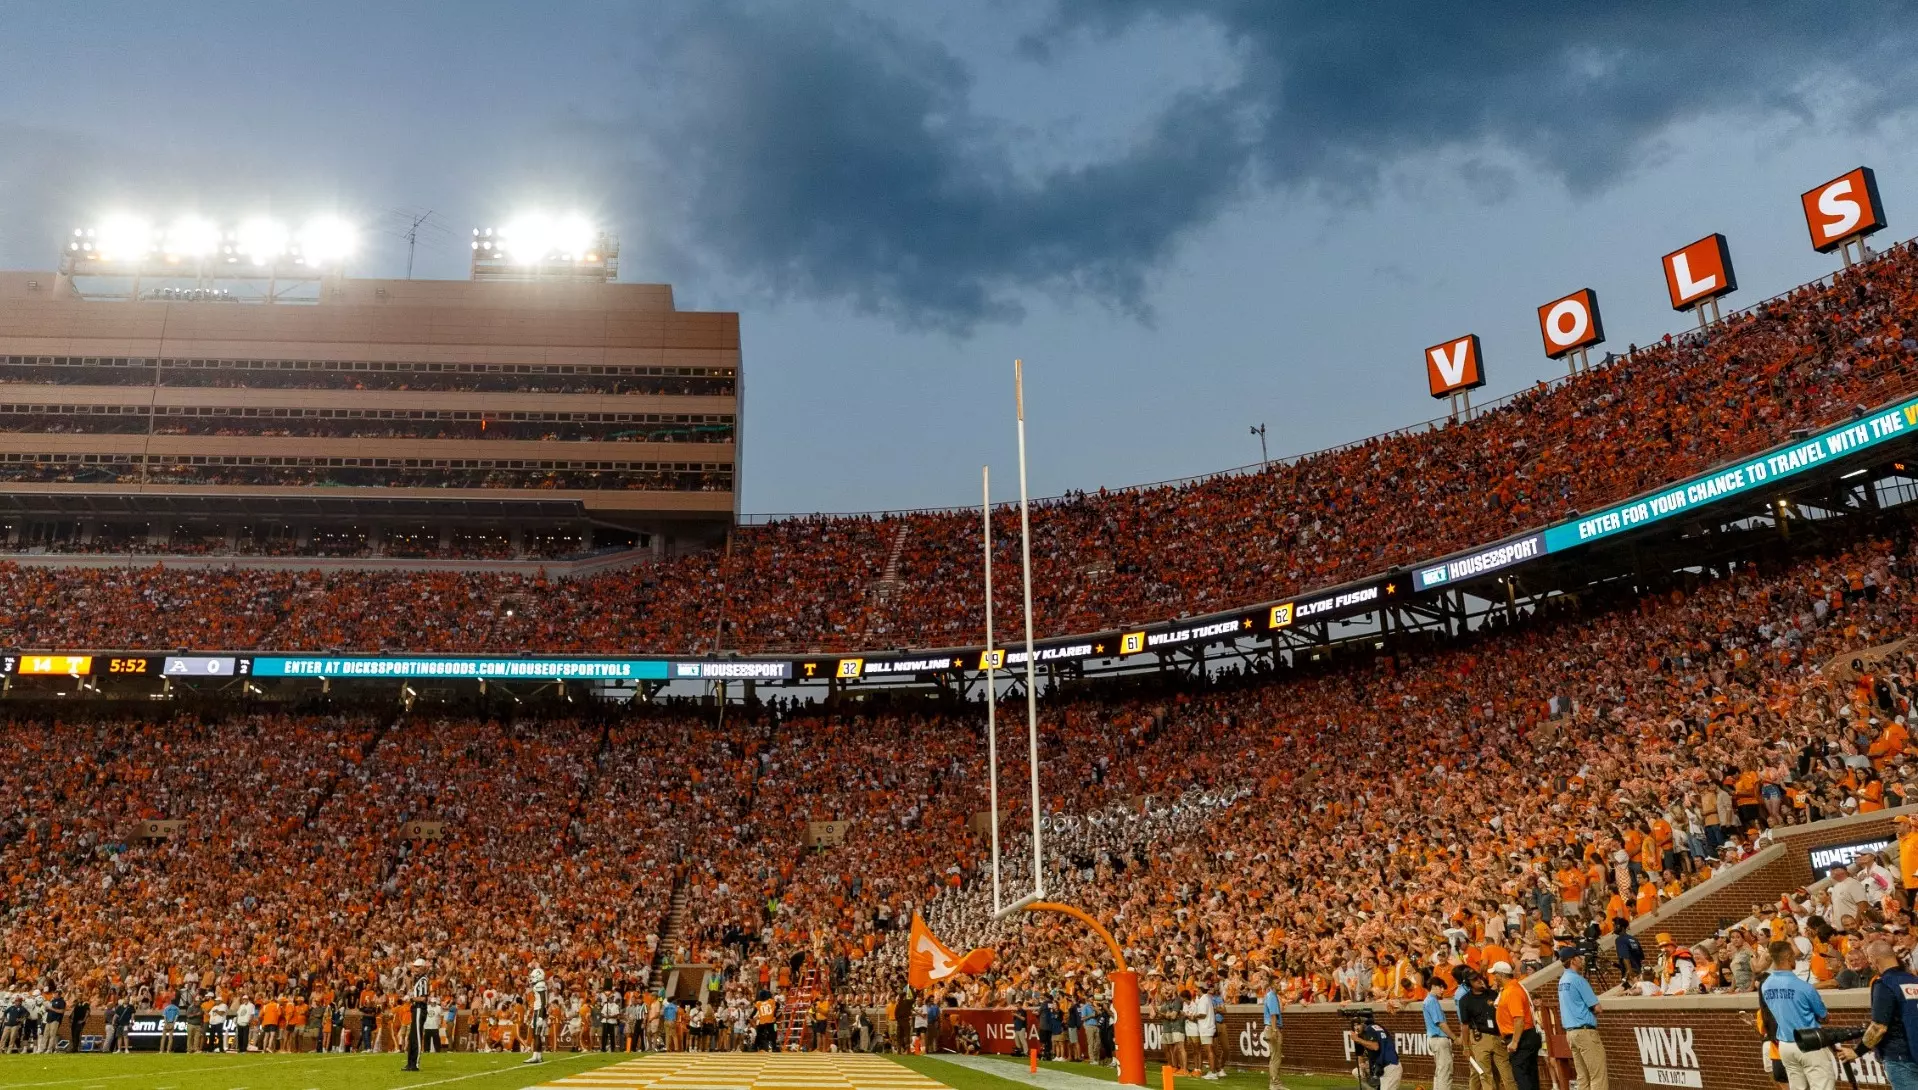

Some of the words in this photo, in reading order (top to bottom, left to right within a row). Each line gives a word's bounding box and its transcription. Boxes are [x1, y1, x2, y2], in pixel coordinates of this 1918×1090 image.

[1430, 339, 1469, 387] V
[1546, 299, 1588, 346] O
[1672, 252, 1716, 301] L
[1818, 179, 1861, 238] S
[1578, 512, 1620, 539] ENTER
[1621, 503, 1648, 525] FOR
[1650, 489, 1686, 516] YOUR
[1688, 469, 1745, 503] CHANCE
[1746, 462, 1767, 484] TO
[1768, 441, 1826, 475] TRAVEL
[1826, 423, 1870, 454] WITH
[1870, 410, 1904, 438] THE
[1499, 538, 1538, 565] SPORT
[1275, 608, 1288, 624] 62
[1296, 598, 1333, 618] CLYDE
[1335, 587, 1378, 608] FUSON
[1127, 637, 1138, 649] 61
[1148, 628, 1189, 646] WILLIS
[1192, 619, 1239, 639] TUCKER
[1042, 645, 1092, 660] KLARER
[4, 663, 12, 671] 3
[33, 658, 51, 672] 14
[110, 659, 147, 673] 5:52
[240, 665, 248, 674] 2
[284, 661, 321, 674] ENTER
[325, 661, 341, 674] AT
[343, 661, 631, 676] DICKSSPORTINGGOODS.COM/HOUSEOFSPORTVOLS
[843, 662, 856, 675] 32
[865, 661, 891, 673] BILL
[893, 658, 950, 672] NOWLING
[1634, 1026, 1699, 1069] WIVK
